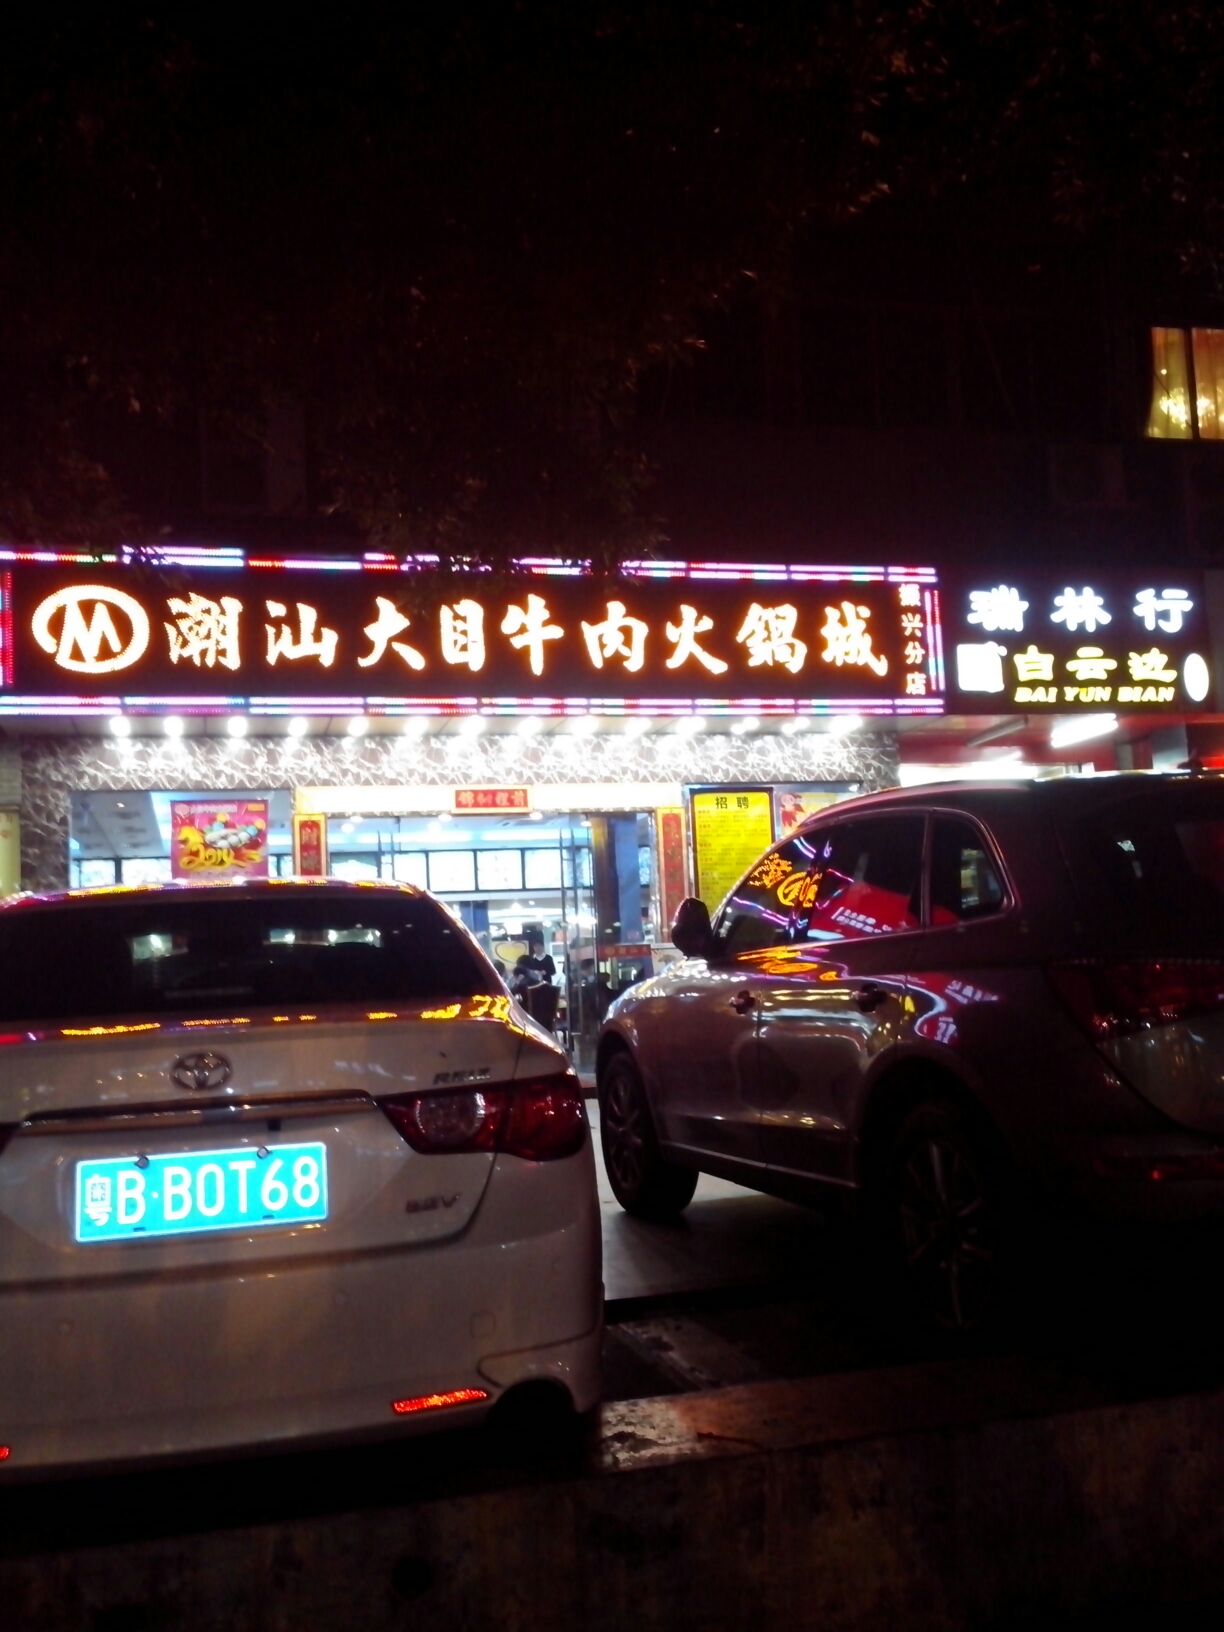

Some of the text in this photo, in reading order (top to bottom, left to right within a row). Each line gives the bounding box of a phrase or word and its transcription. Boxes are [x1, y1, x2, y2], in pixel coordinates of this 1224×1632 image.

[1013, 645, 1177, 683] 白云边
[1015, 687, 1175, 702] BAI YUN BIAN
